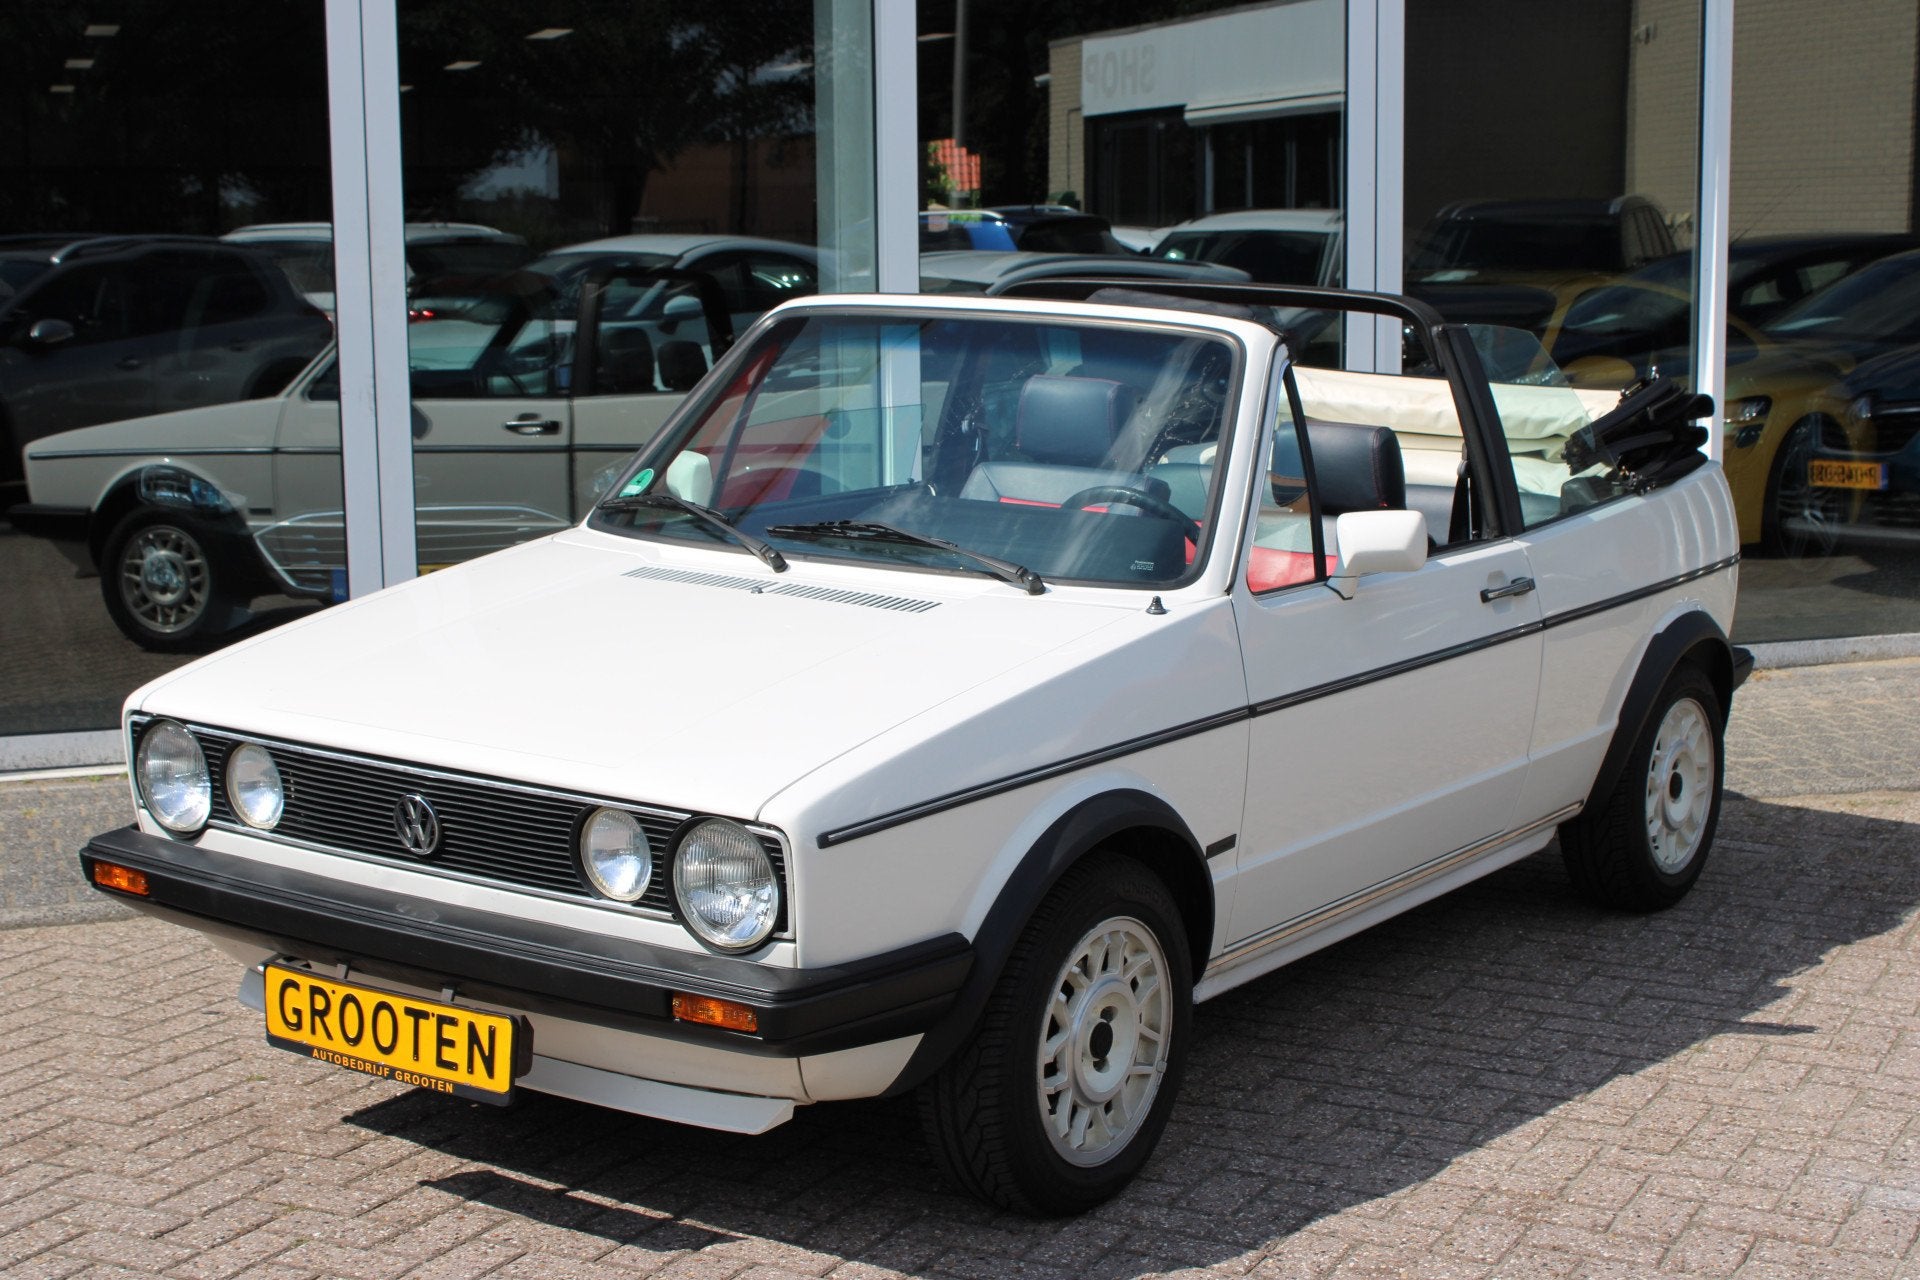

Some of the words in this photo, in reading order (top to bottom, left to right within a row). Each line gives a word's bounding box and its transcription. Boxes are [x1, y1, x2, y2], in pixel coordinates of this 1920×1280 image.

[279, 978, 496, 1080] GROOTEN
[312, 1048, 390, 1078] AUTOBEDRIJF
[395, 1070, 454, 1094] GROOTEN
